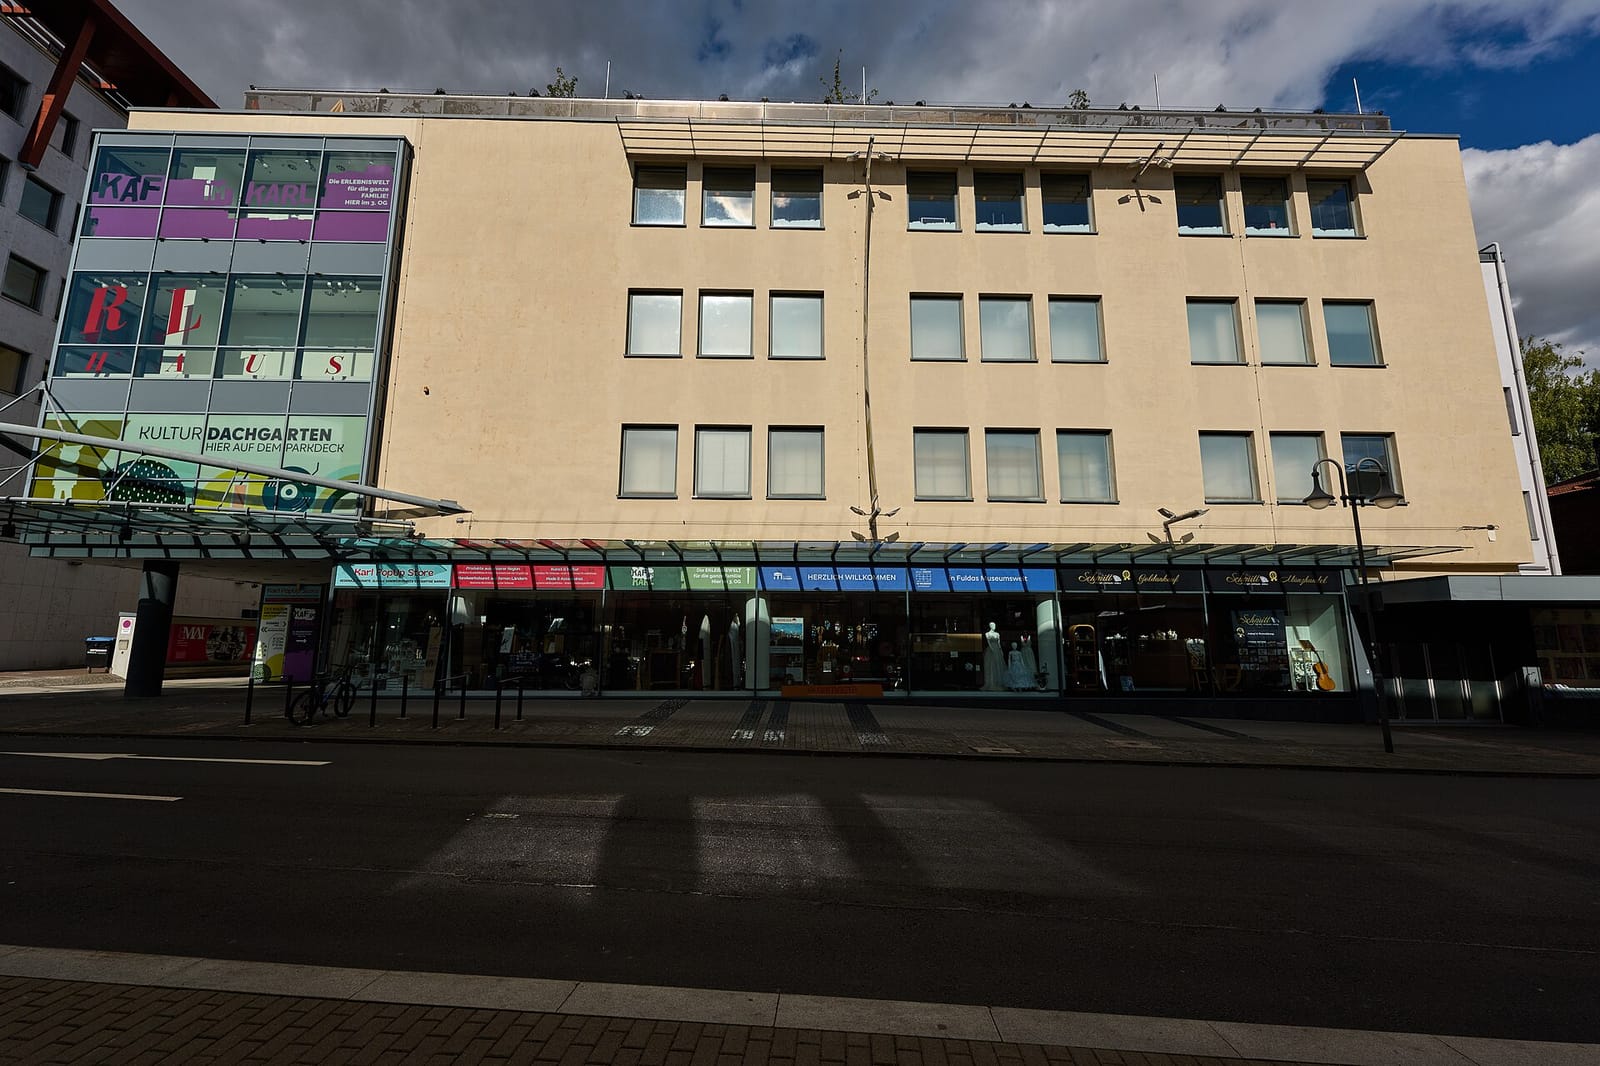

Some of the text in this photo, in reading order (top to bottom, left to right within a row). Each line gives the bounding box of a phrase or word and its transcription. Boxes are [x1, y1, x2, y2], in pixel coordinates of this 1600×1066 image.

[98, 174, 163, 202] KAF
[139, 426, 332, 442] KULTUR DACHGARTEN
[205, 442, 345, 453] HIER AUF DEM PARKDECK
[354, 568, 374, 576] Karl
[407, 569, 434, 577] Store
[807, 573, 843, 581] HERZLICH
